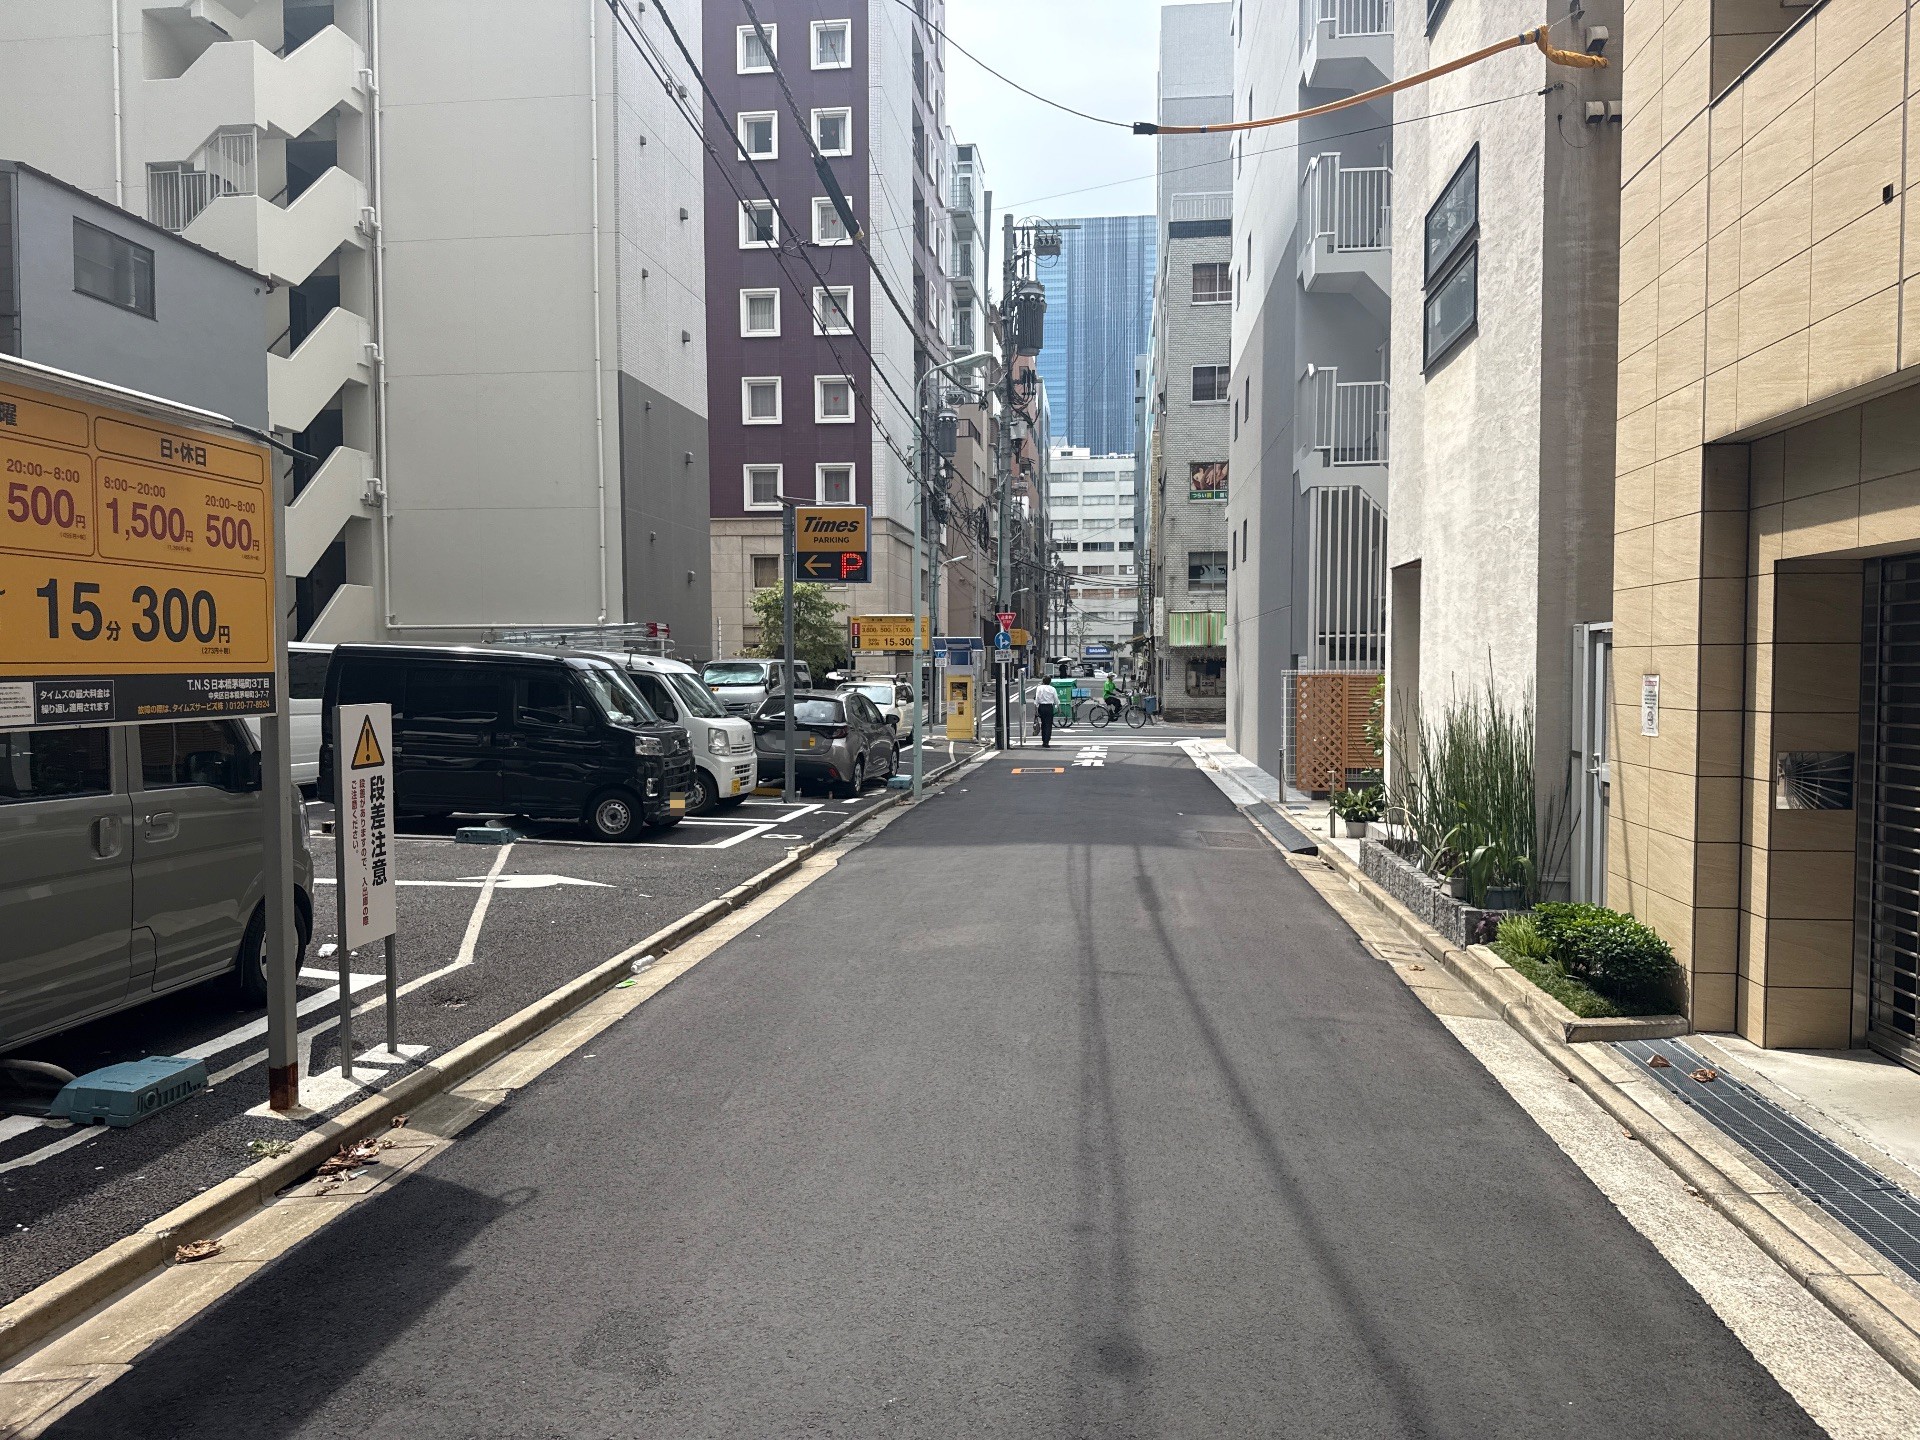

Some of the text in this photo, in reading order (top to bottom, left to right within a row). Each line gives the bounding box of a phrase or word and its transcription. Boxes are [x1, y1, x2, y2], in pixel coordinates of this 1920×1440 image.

[803, 516, 860, 533] Times
[813, 536, 850, 544] PARKING
[841, 552, 863, 579] P
[40, 688, 110, 700] タイムズの最大料金は
[41, 702, 110, 714] 繰り返し適用されます
[370, 775, 388, 886] 段差注意
